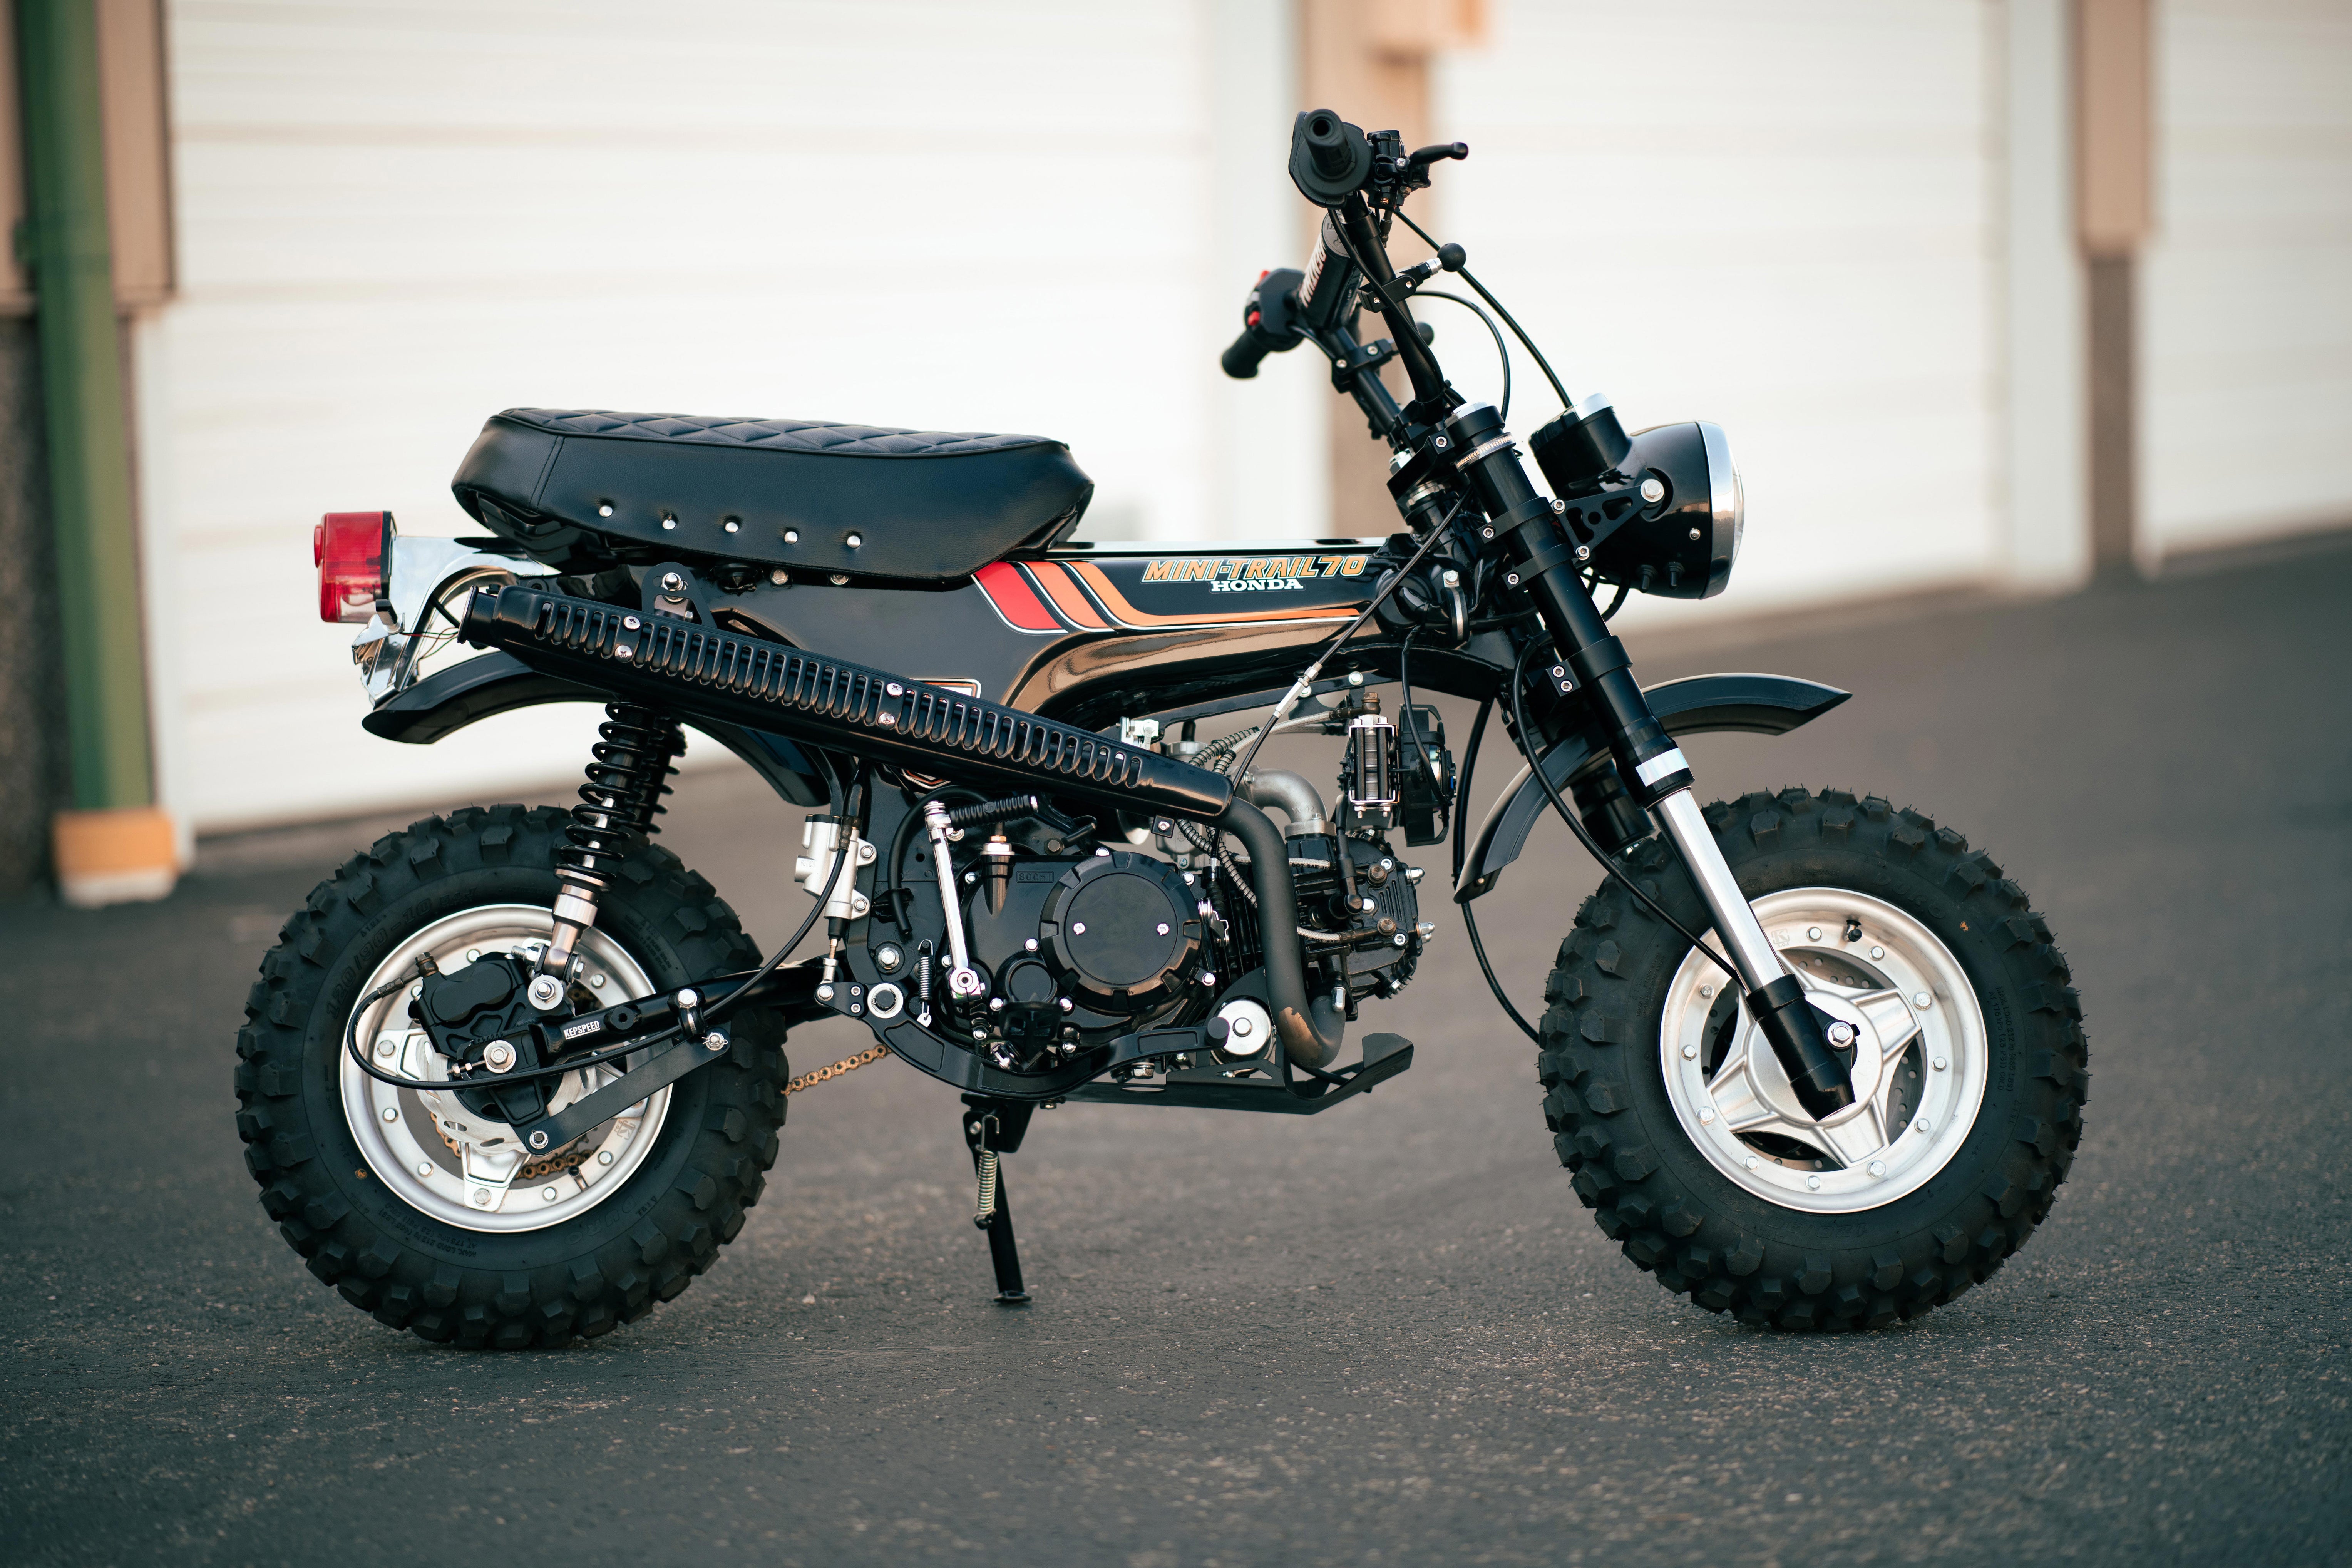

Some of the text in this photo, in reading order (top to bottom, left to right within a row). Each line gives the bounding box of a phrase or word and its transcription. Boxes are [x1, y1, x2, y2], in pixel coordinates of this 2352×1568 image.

[1142, 556, 1368, 582] MINI-TRAIL 70
[1211, 579, 1304, 592] HONDA
[1019, 873, 1051, 881] 800ml
[1873, 872, 1945, 919] DURO
[564, 1020, 600, 1039] KEPSPEED
